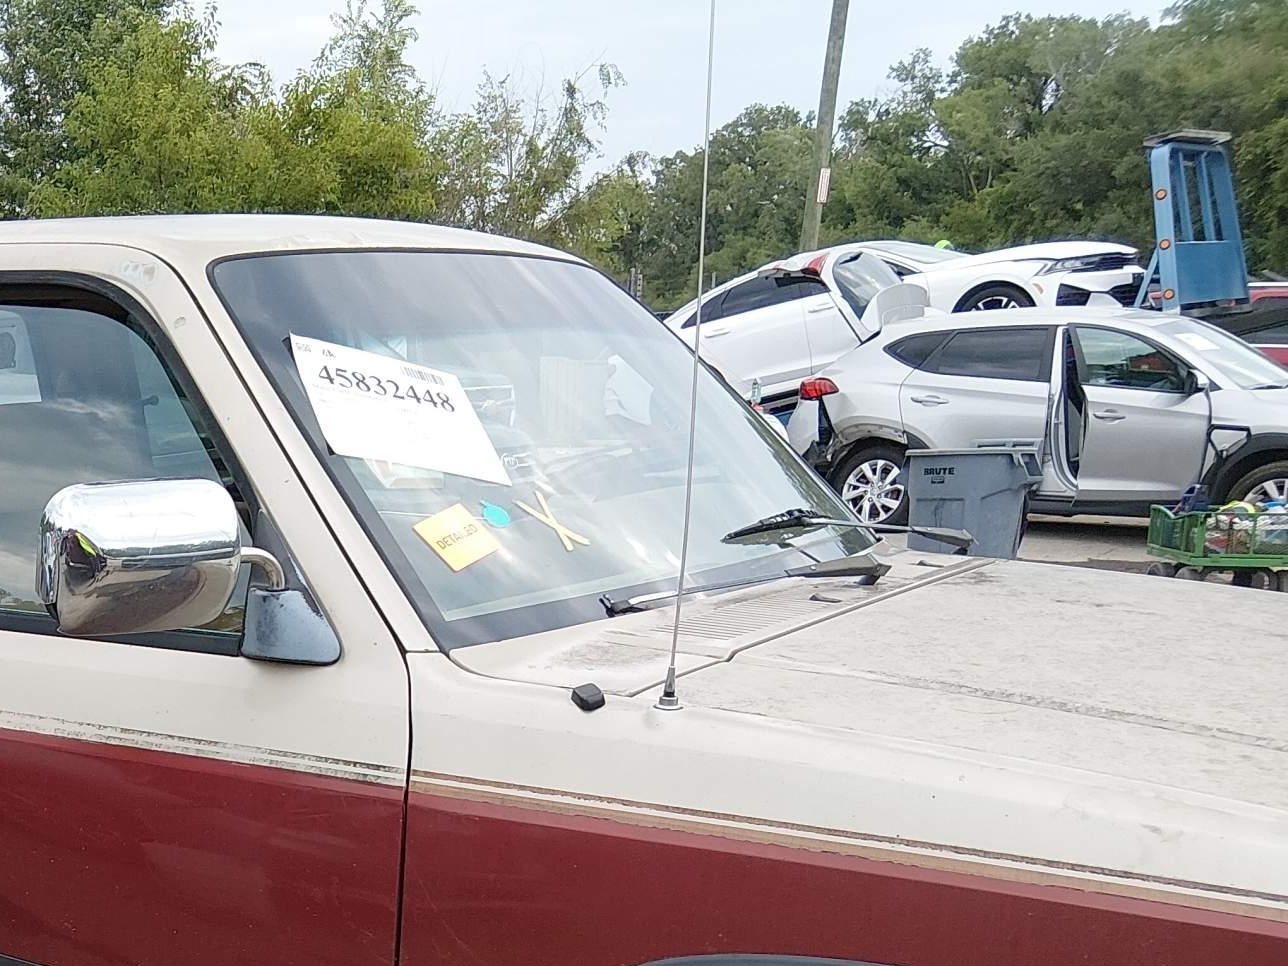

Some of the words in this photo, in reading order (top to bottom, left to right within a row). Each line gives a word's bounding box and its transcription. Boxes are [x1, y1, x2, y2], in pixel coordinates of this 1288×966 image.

[318, 365, 455, 413] 45832448
[923, 467, 955, 476] BRUTE
[436, 523, 479, 550] DETAED
